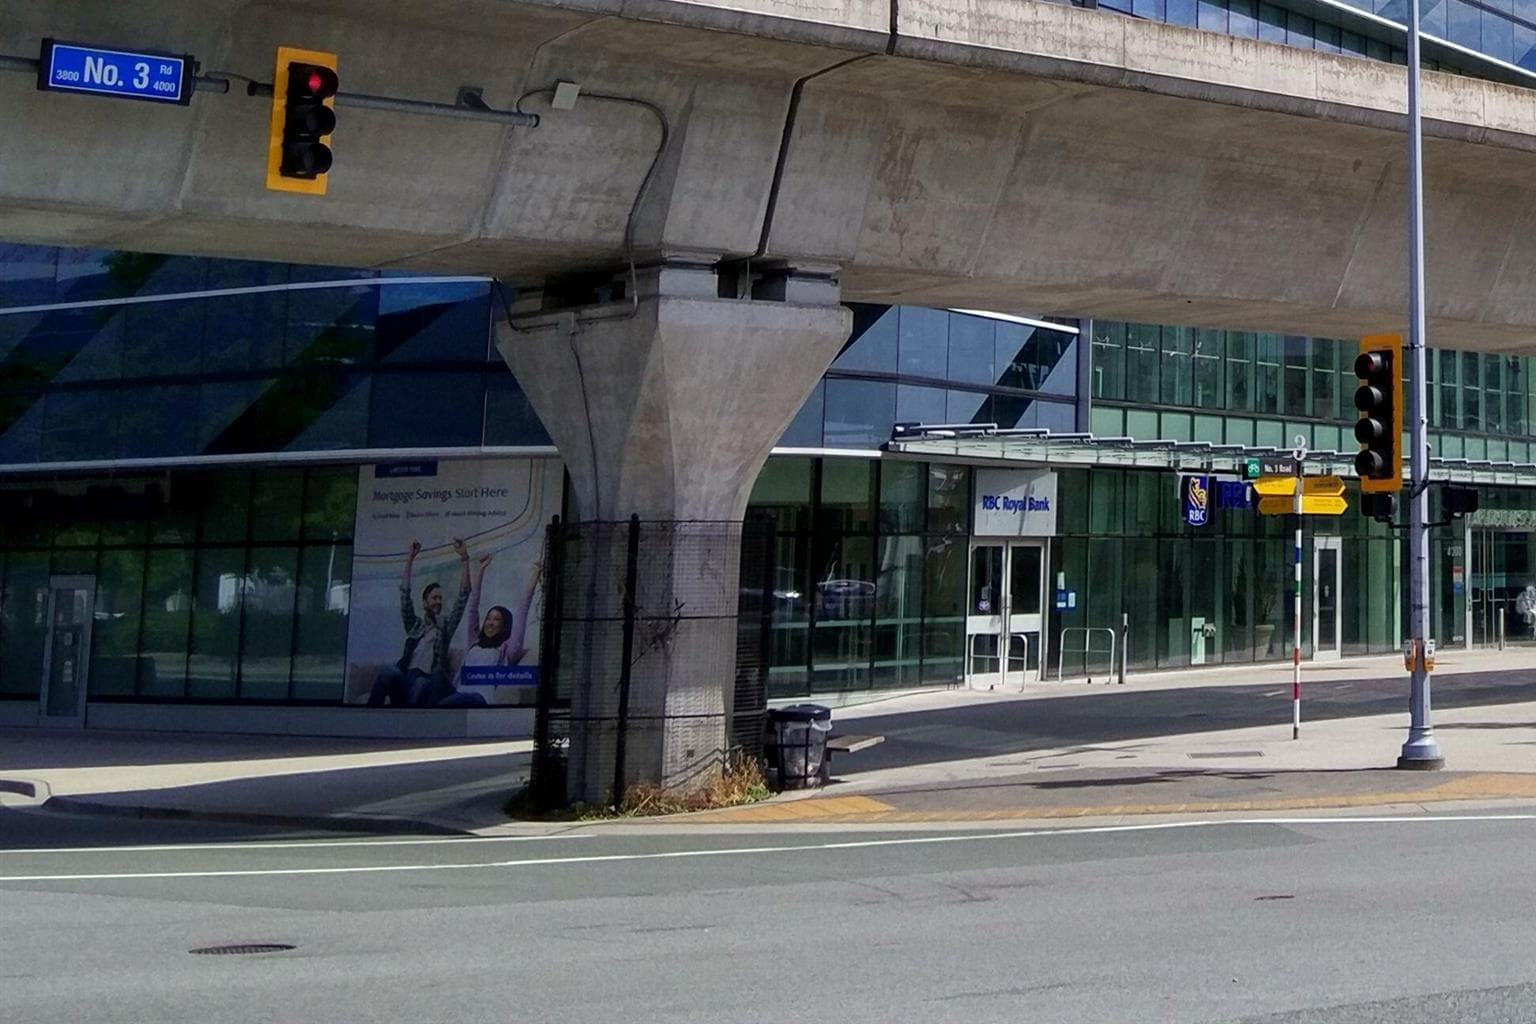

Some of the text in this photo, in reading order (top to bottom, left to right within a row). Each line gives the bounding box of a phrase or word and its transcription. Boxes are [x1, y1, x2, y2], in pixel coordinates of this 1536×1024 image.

[56, 69, 80, 81] 3800
[83, 56, 150, 89] No. 3
[159, 65, 173, 75] Rd
[153, 81, 176, 92] 4000
[372, 487, 509, 504] Mortgage Savings Start Here
[982, 495, 1050, 515] RBC Royal Bank
[1189, 510, 1205, 521] RBC
